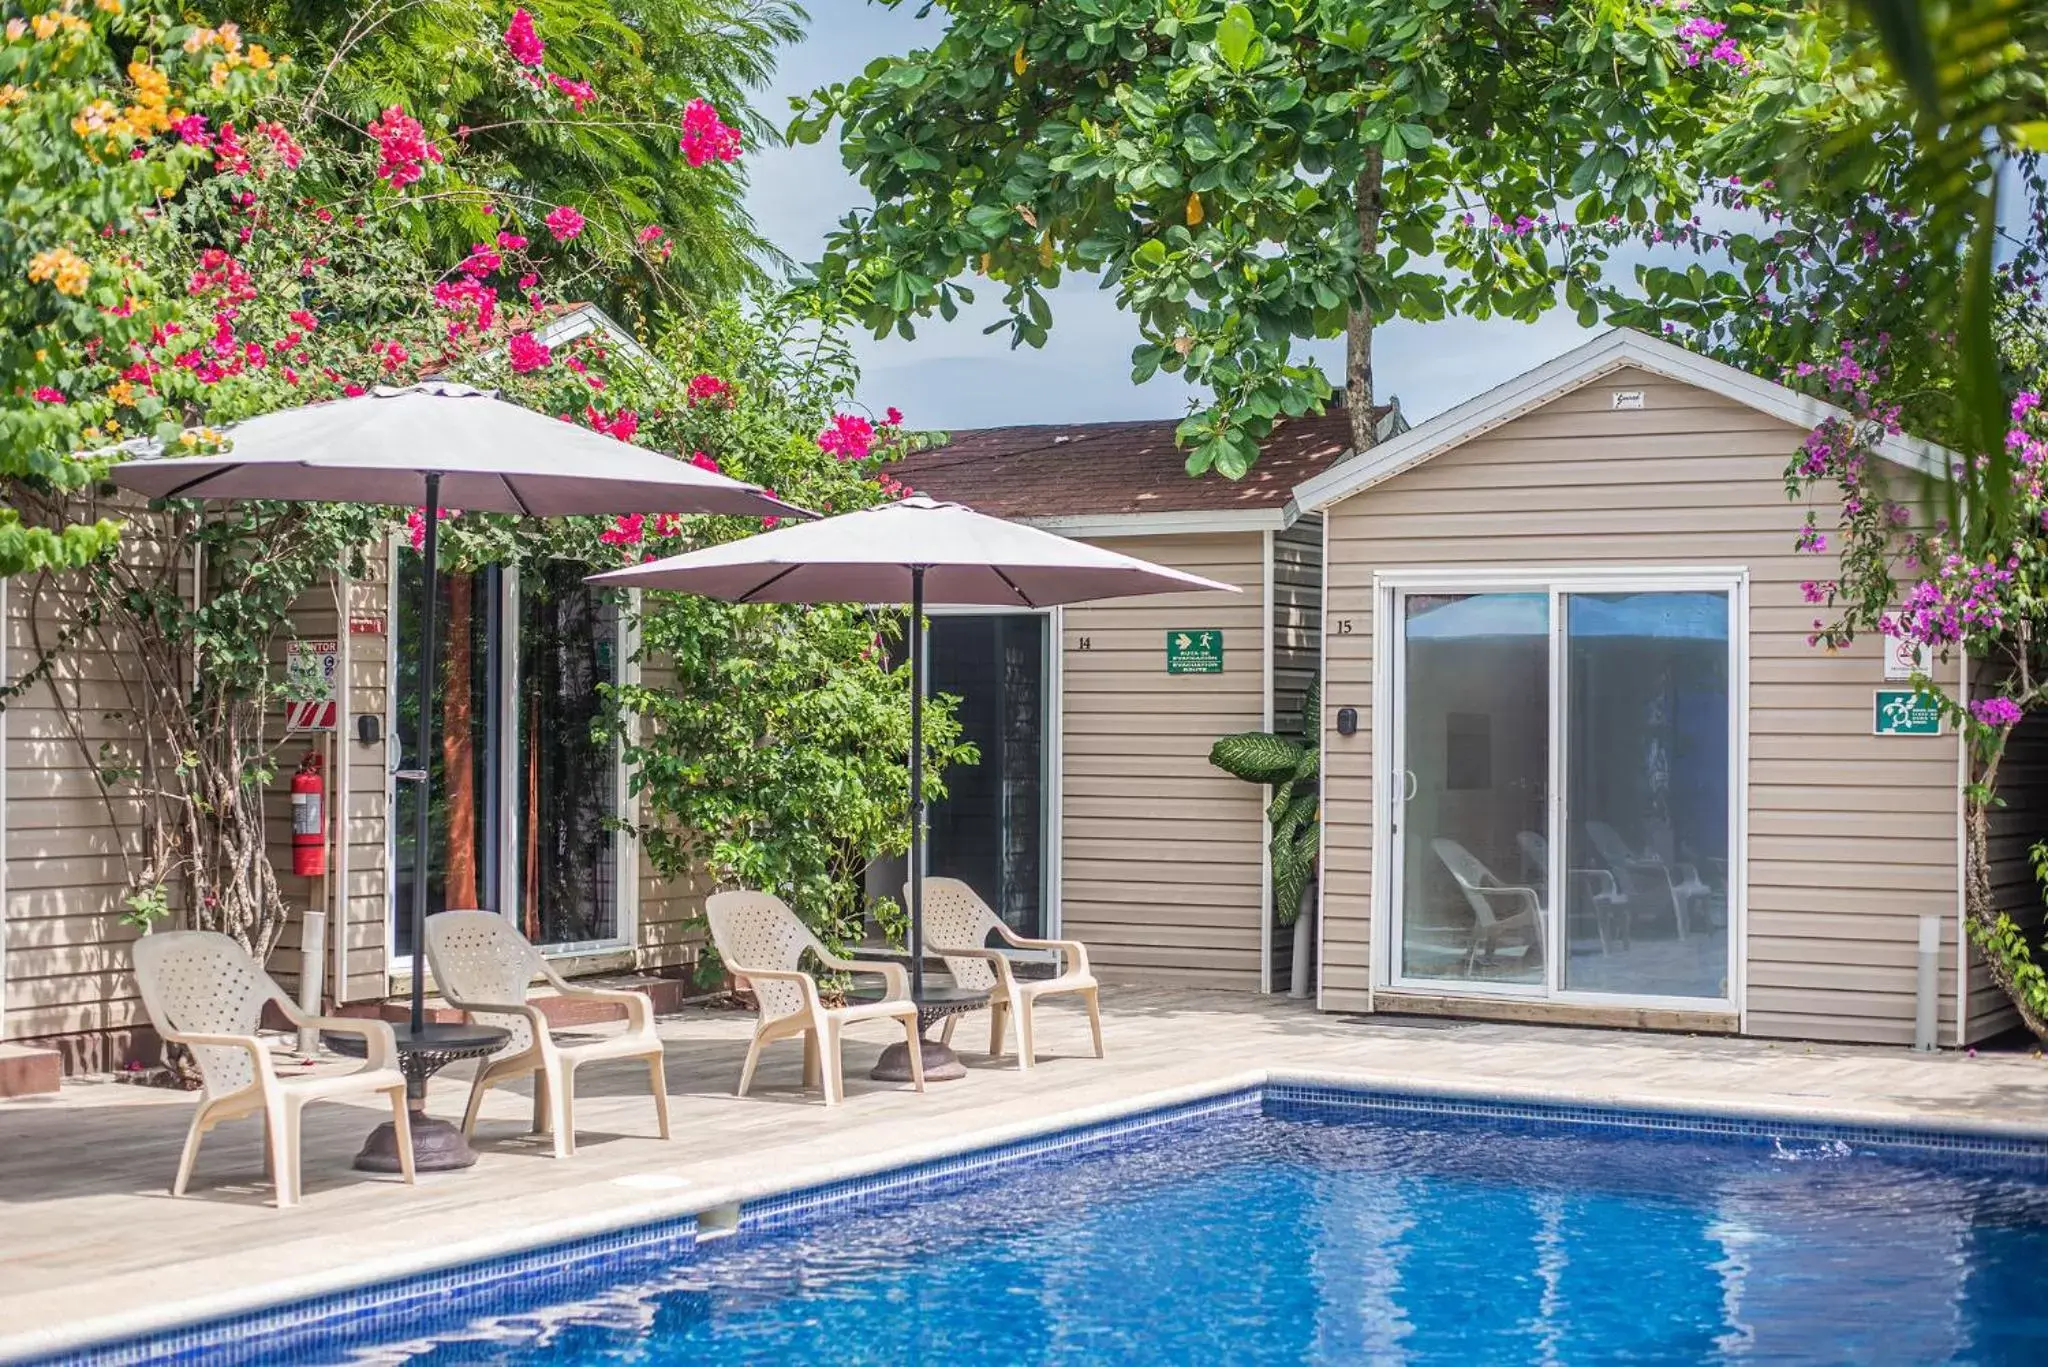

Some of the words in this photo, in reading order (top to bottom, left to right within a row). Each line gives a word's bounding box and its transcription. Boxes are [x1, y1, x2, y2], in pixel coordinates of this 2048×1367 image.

[1337, 619, 1352, 633] 15
[289, 642, 336, 652] ENTOR
[1079, 636, 1091, 650] 14
